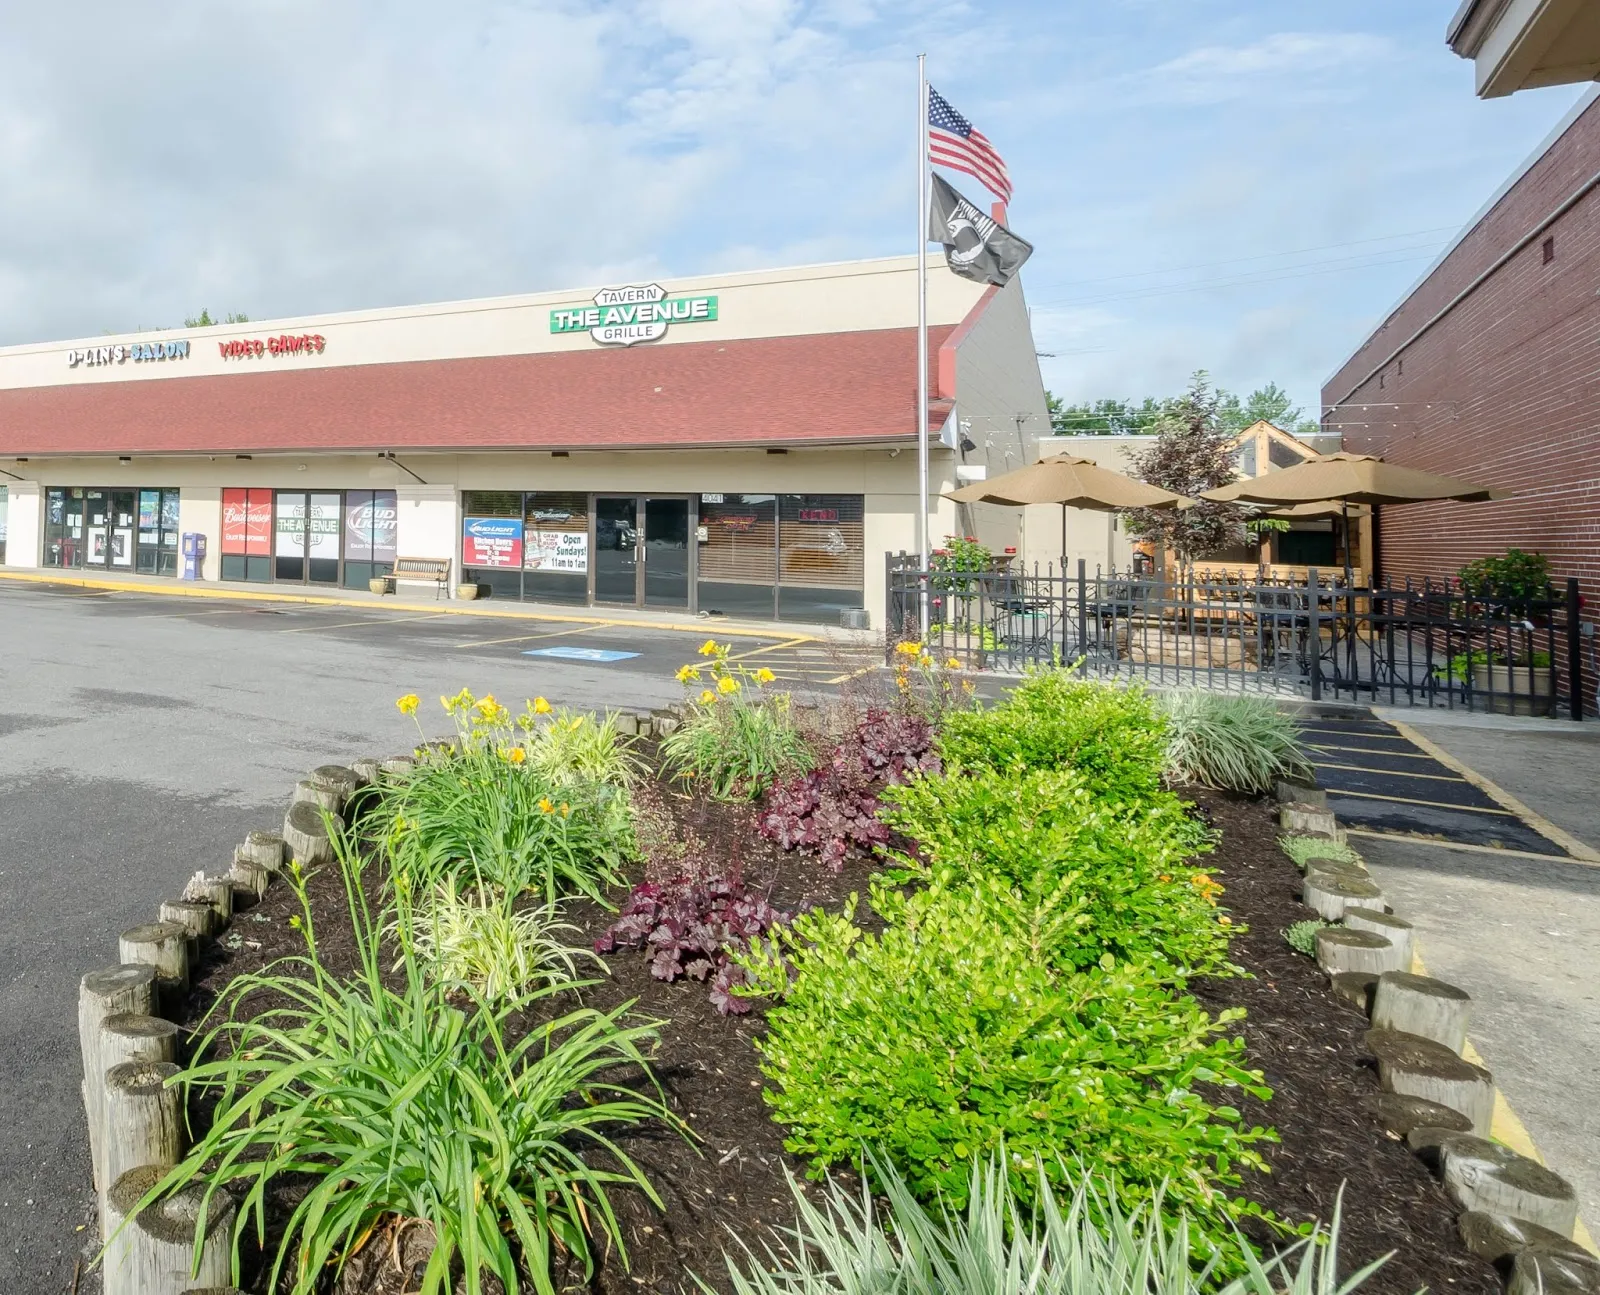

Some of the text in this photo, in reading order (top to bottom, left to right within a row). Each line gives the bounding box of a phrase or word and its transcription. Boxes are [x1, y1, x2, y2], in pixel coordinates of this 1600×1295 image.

[947, 199, 998, 243] POW MIA
[602, 288, 657, 304] TAVERN
[554, 299, 710, 329] THE AVENUE
[603, 325, 653, 340] GRILLE
[66, 340, 190, 367] D-LIN'S SALON
[218, 334, 326, 359] VIDEO GAMES
[702, 494, 722, 503] 4041
[223, 506, 271, 523] Budweiser
[361, 505, 396, 519] BUD
[801, 509, 836, 520] KENO
[278, 519, 337, 532] THE AVENUE
[355, 517, 398, 530] LIGHT
[563, 535, 581, 546] Open
[556, 546, 586, 558] Sundays!
[552, 558, 586, 568] 11am to 1am
